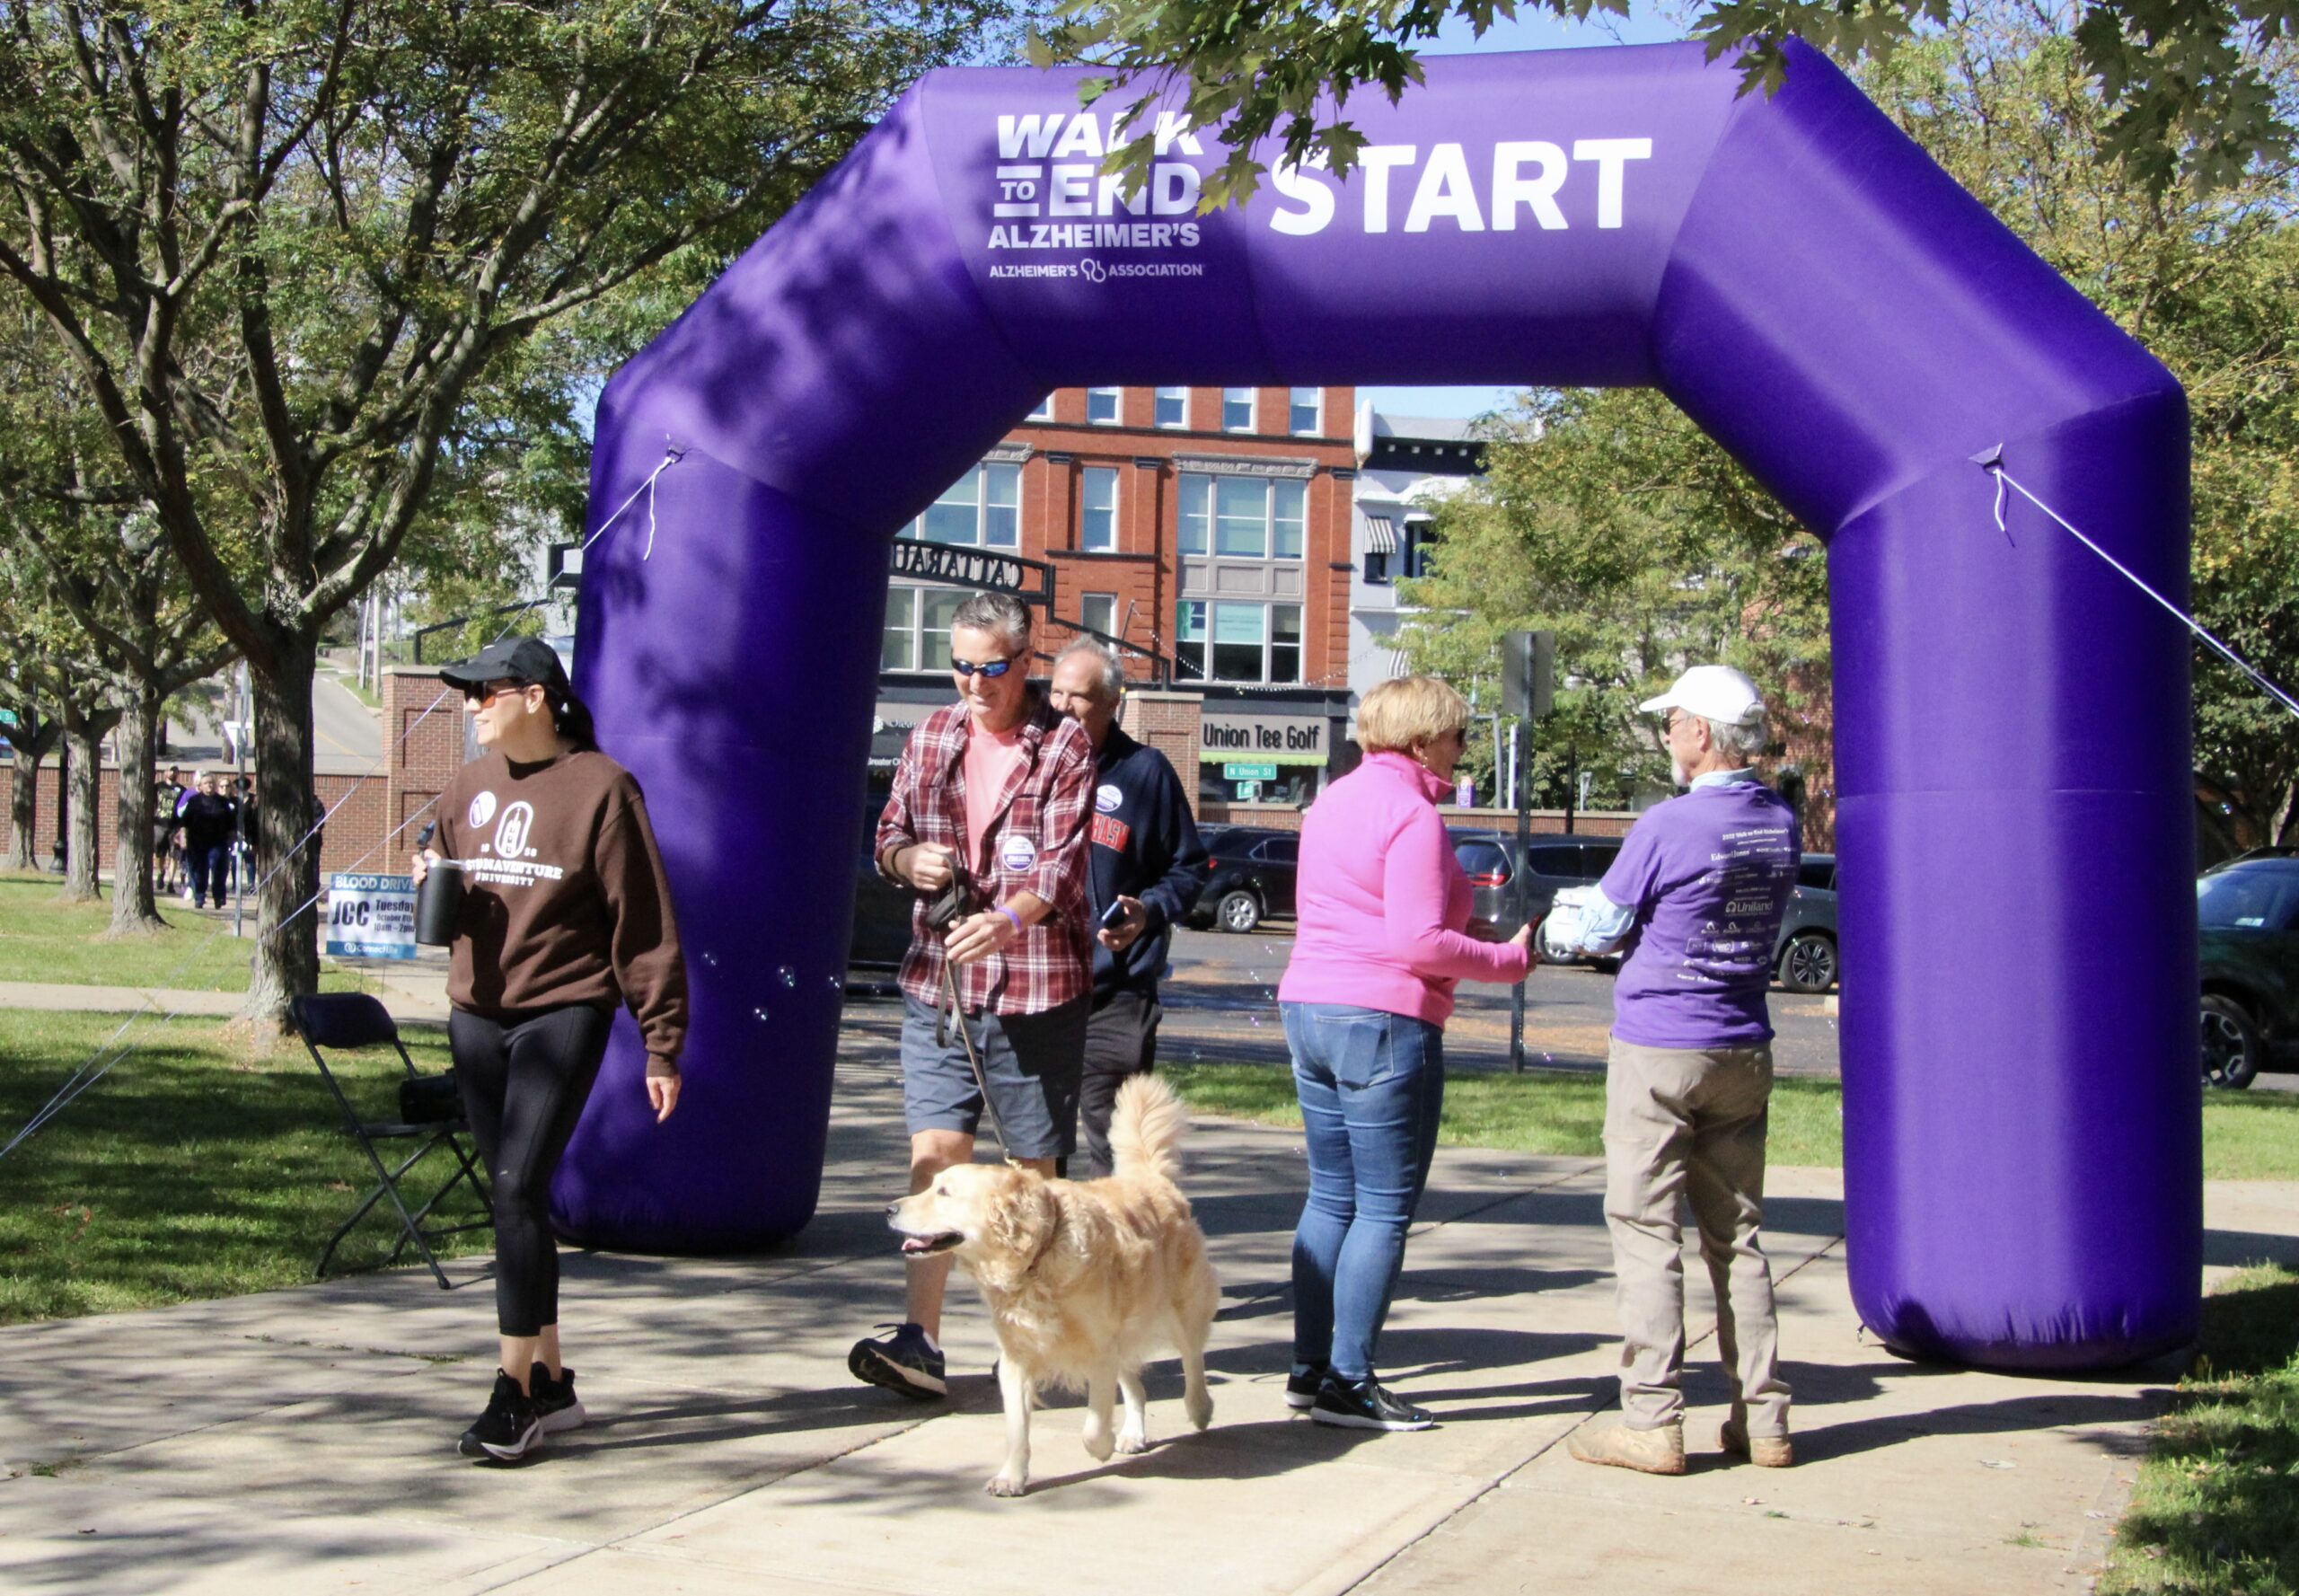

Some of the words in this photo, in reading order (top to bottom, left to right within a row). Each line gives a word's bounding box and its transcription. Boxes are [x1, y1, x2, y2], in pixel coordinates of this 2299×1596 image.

[998, 111, 1203, 158] WALK
[1000, 181, 1035, 200] TO
[1049, 163, 1202, 216] END
[1269, 137, 1652, 235] START
[988, 223, 1201, 249] ALZHEIMER'S
[990, 265, 1078, 278] ALZHEIMER'S
[1109, 264, 1203, 276] ASSOCIATION
[1203, 723, 1249, 747] Union
[1255, 725, 1282, 749] Tee
[1287, 726, 1320, 750] Golf
[1229, 767, 1236, 776] N
[1238, 767, 1259, 776] Union
[1263, 767, 1272, 777] St
[335, 876, 377, 889] BLOOD
[332, 900, 370, 927] JCC
[375, 899, 414, 913] Tuesday
[1737, 900, 1774, 913] Uniland
[376, 913, 401, 922] October
